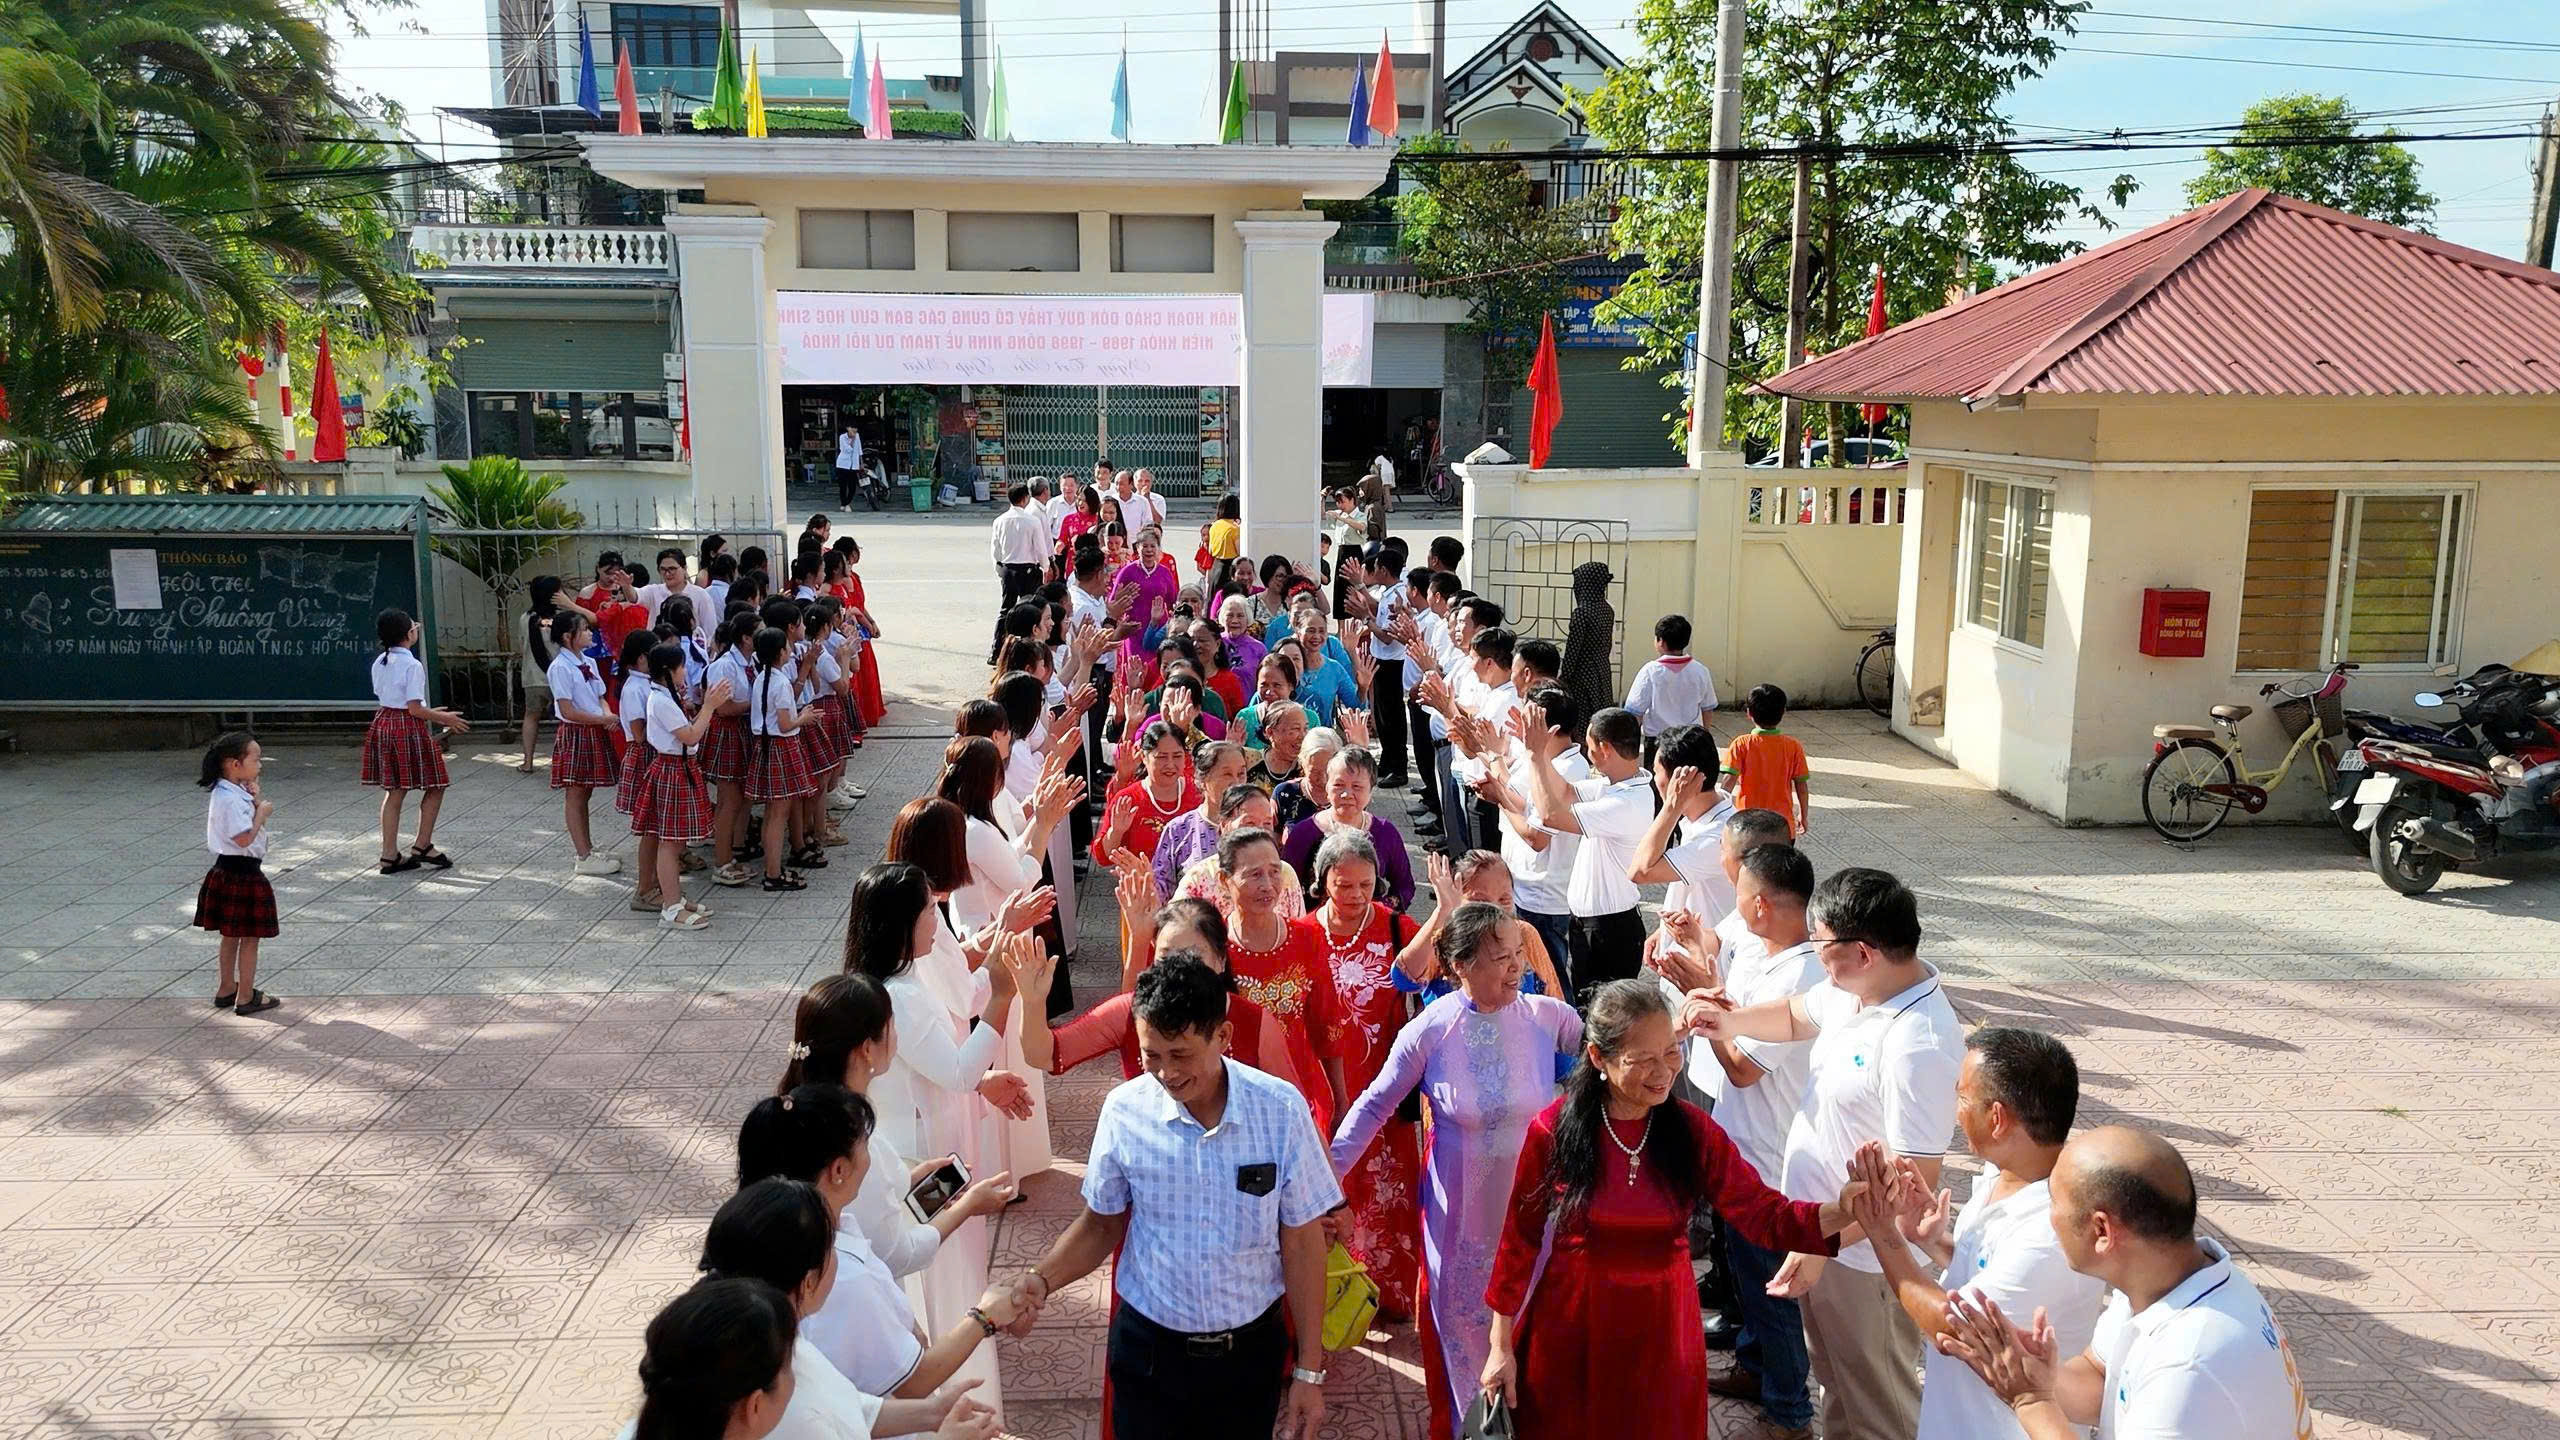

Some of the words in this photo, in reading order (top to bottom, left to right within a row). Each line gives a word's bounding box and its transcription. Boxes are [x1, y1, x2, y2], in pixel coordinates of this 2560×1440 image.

[160, 550, 213, 565] THÔNG
[216, 549, 248, 565] BÁO
[55, 638, 75, 654] 95
[78, 634, 106, 655] NĂM
[110, 635, 142, 655] NGÀY
[218, 635, 255, 656] ĐOÀN
